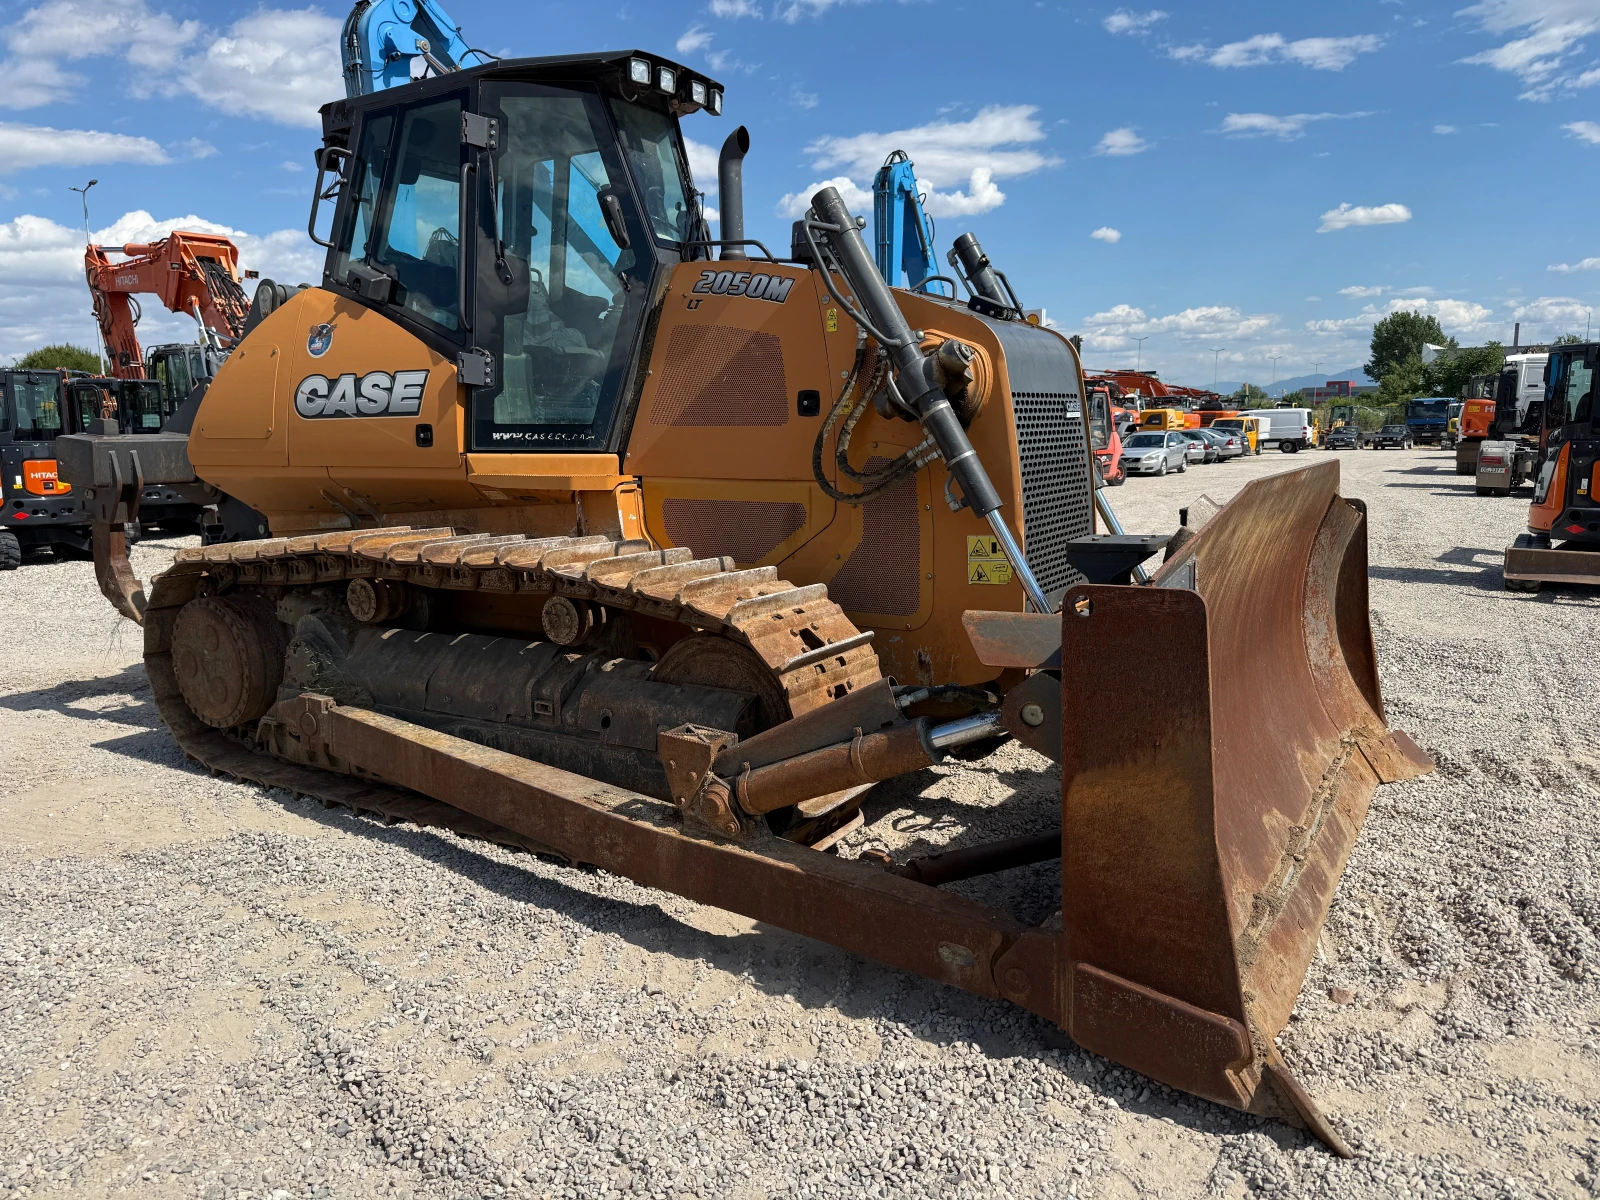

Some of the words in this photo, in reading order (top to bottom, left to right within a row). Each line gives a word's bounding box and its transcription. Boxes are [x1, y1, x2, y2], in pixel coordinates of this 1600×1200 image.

[115, 275, 138, 287] HITACHI
[692, 270, 795, 304] 2050M
[686, 299, 703, 311] LT
[295, 371, 429, 417] CASE
[30, 471, 58, 479] HITAC
